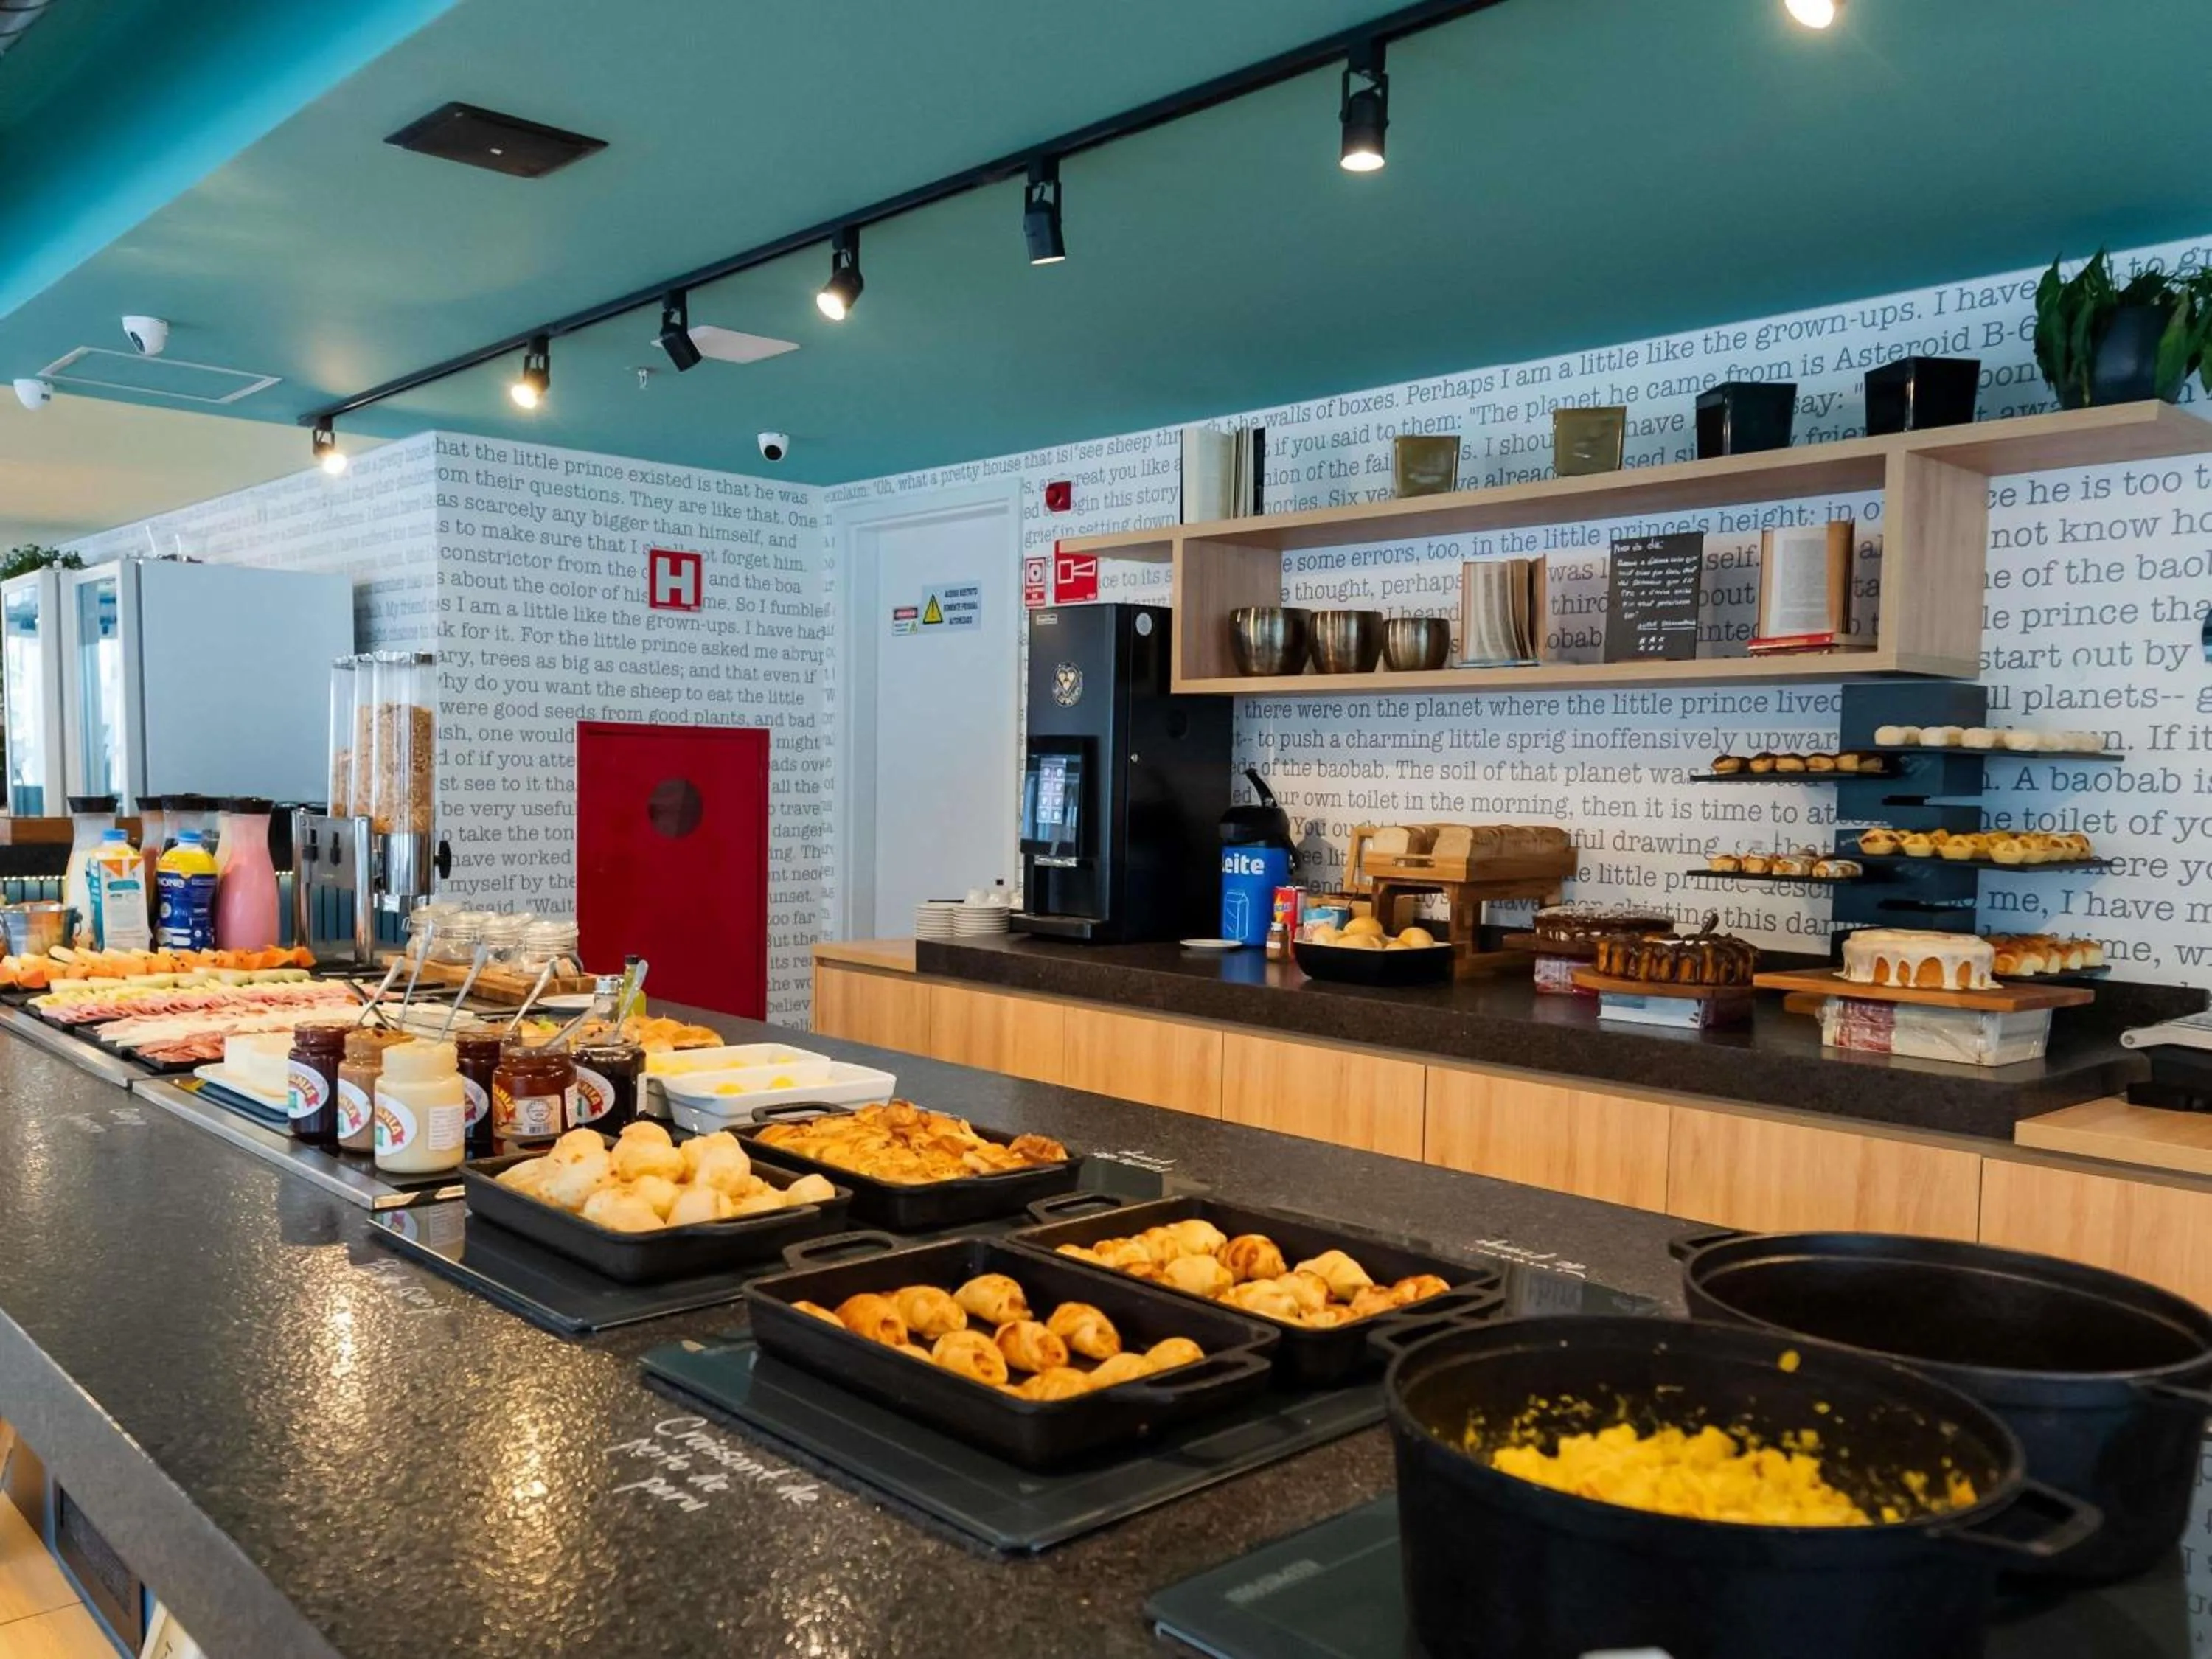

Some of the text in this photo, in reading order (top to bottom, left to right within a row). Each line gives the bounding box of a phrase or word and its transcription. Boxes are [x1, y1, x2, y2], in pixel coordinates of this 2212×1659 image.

[1515, 301, 1922, 387] am little like the grown-ups.
[1265, 375, 1495, 428] walls boxes. Perhaps
[1291, 353, 1824, 459] you said to he came is
[1024, 436, 1152, 470] that see sheep
[475, 444, 808, 505] the little prince existed that was
[1107, 457, 1170, 487] you like
[1306, 459, 1360, 481] of the
[2123, 471, 2183, 496] too
[475, 470, 818, 529] their questions. They are like that. One
[1103, 485, 1179, 509] this story
[464, 496, 548, 524] scarcely
[552, 508, 587, 528] any
[591, 509, 650, 533] bigger
[653, 518, 694, 537] than
[768, 533, 797, 549] and
[1024, 525, 1058, 549] grief
[1992, 516, 2162, 549] not know
[481, 524, 808, 573] make sure that forget him.
[1297, 554, 1346, 571] some
[1351, 546, 1420, 567] errors,
[1427, 542, 1465, 560] too,
[1500, 530, 1537, 554] the
[1543, 526, 1601, 549] little
[1717, 505, 1815, 538] height:
[439, 546, 803, 594] constrictor from the and the boa
[451, 570, 598, 599] about the color
[655, 556, 695, 604] H
[1295, 578, 1374, 602] thought,
[1548, 563, 1593, 582] was
[2065, 557, 2125, 585] the
[523, 601, 793, 639] little like the grown-ups. have
[2018, 601, 2139, 635] prince
[461, 622, 750, 658] for it. For the little prince asked
[2072, 641, 2133, 667] out
[480, 648, 531, 668] trees
[561, 653, 590, 675] big
[689, 664, 721, 679] and
[725, 664, 760, 681] that
[762, 670, 801, 684] even
[502, 678, 805, 706] you want the sheep eat the little
[439, 701, 815, 728] were good seeds and bad
[1245, 692, 1768, 723] there were the planet where the little prince
[478, 728, 514, 742] one
[1279, 728, 1567, 754] push charming little sprig
[496, 754, 535, 771] you
[1281, 757, 1643, 787] the baobab. The soil that planet
[464, 778, 496, 791] see
[2049, 766, 2182, 794] baobab
[470, 804, 516, 821] very
[1304, 790, 1766, 822] own toilet the morning, then time
[458, 824, 539, 842] take the
[1293, 816, 1327, 838] You
[2020, 807, 2118, 837] toilet
[501, 849, 571, 866] worked
[448, 874, 518, 896] myself
[1597, 862, 1658, 888] little
[1724, 906, 1777, 933] this
[1987, 890, 2174, 922] me, have
